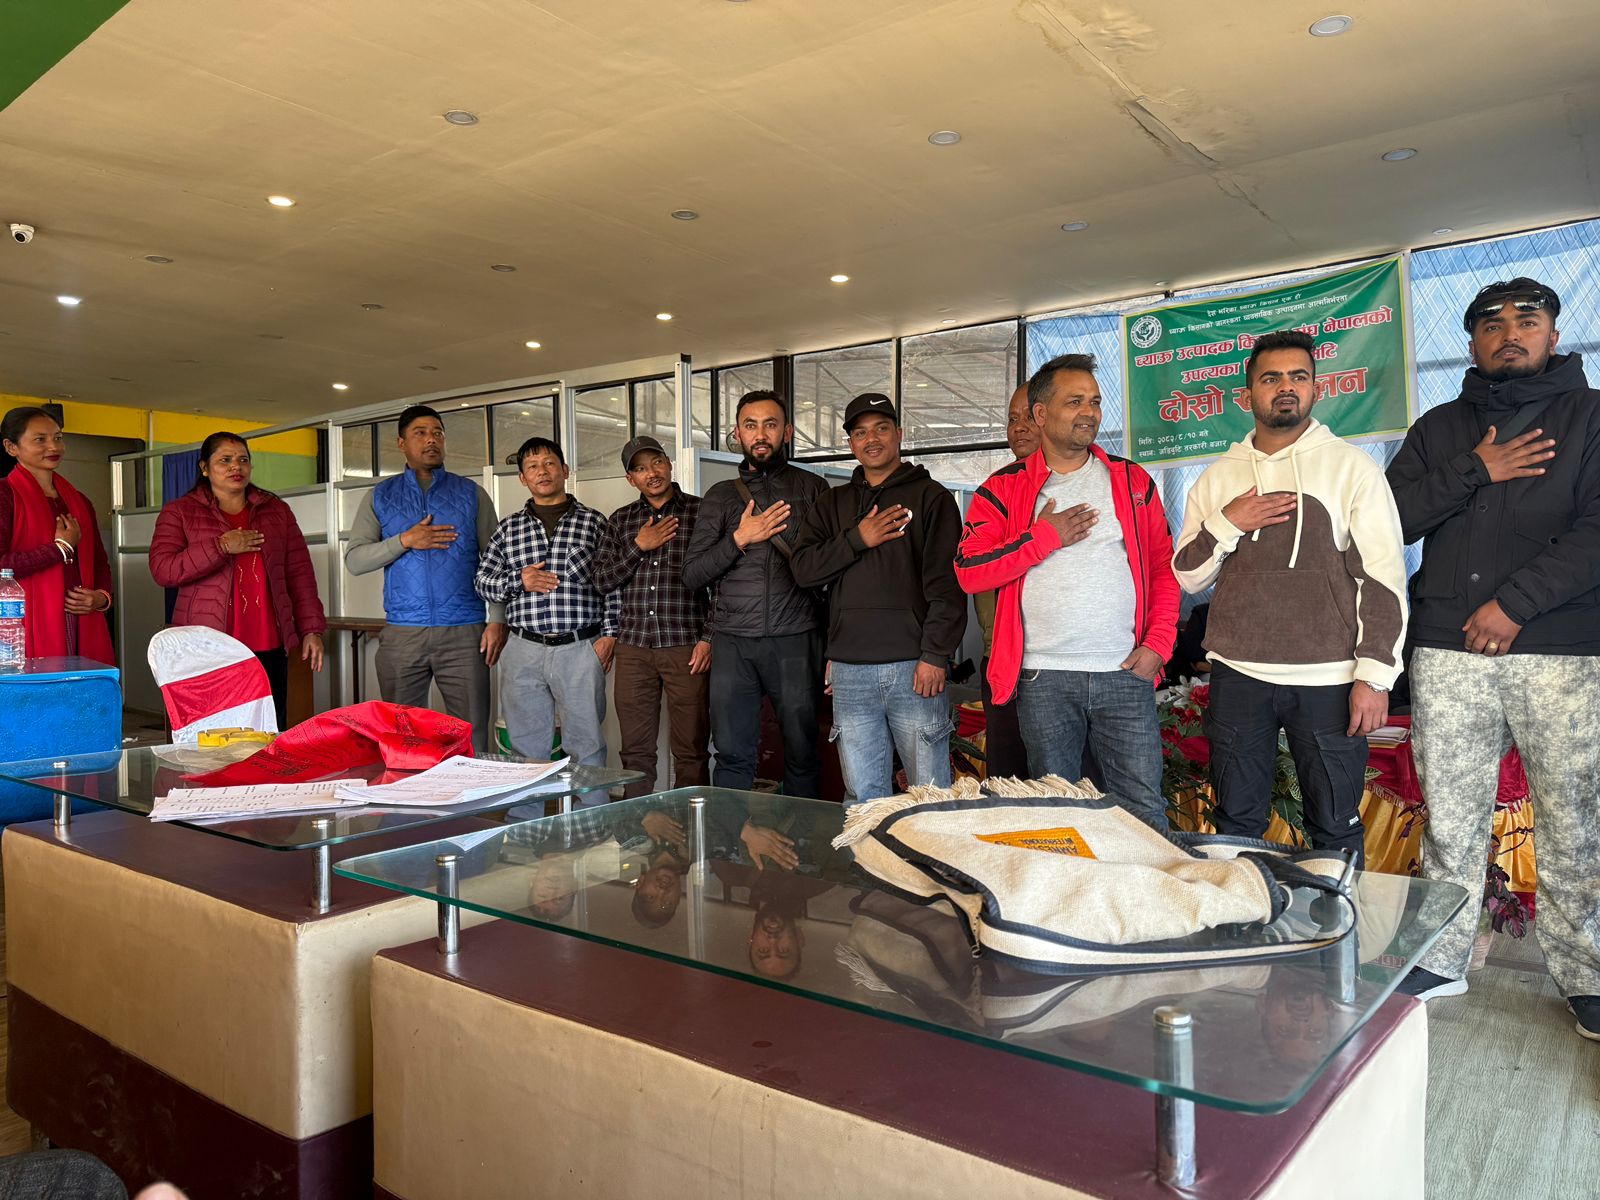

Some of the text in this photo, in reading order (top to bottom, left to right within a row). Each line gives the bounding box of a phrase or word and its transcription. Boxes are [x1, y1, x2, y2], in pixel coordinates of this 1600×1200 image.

[1135, 350, 1174, 367] च्याऊ
[1176, 339, 1235, 360] उत्पादक
[1323, 305, 1393, 334] नेपालको
[1181, 362, 1241, 384] उपत्यका
[1199, 428, 1209, 437] गते
[1184, 441, 1207, 451] तरकारी
